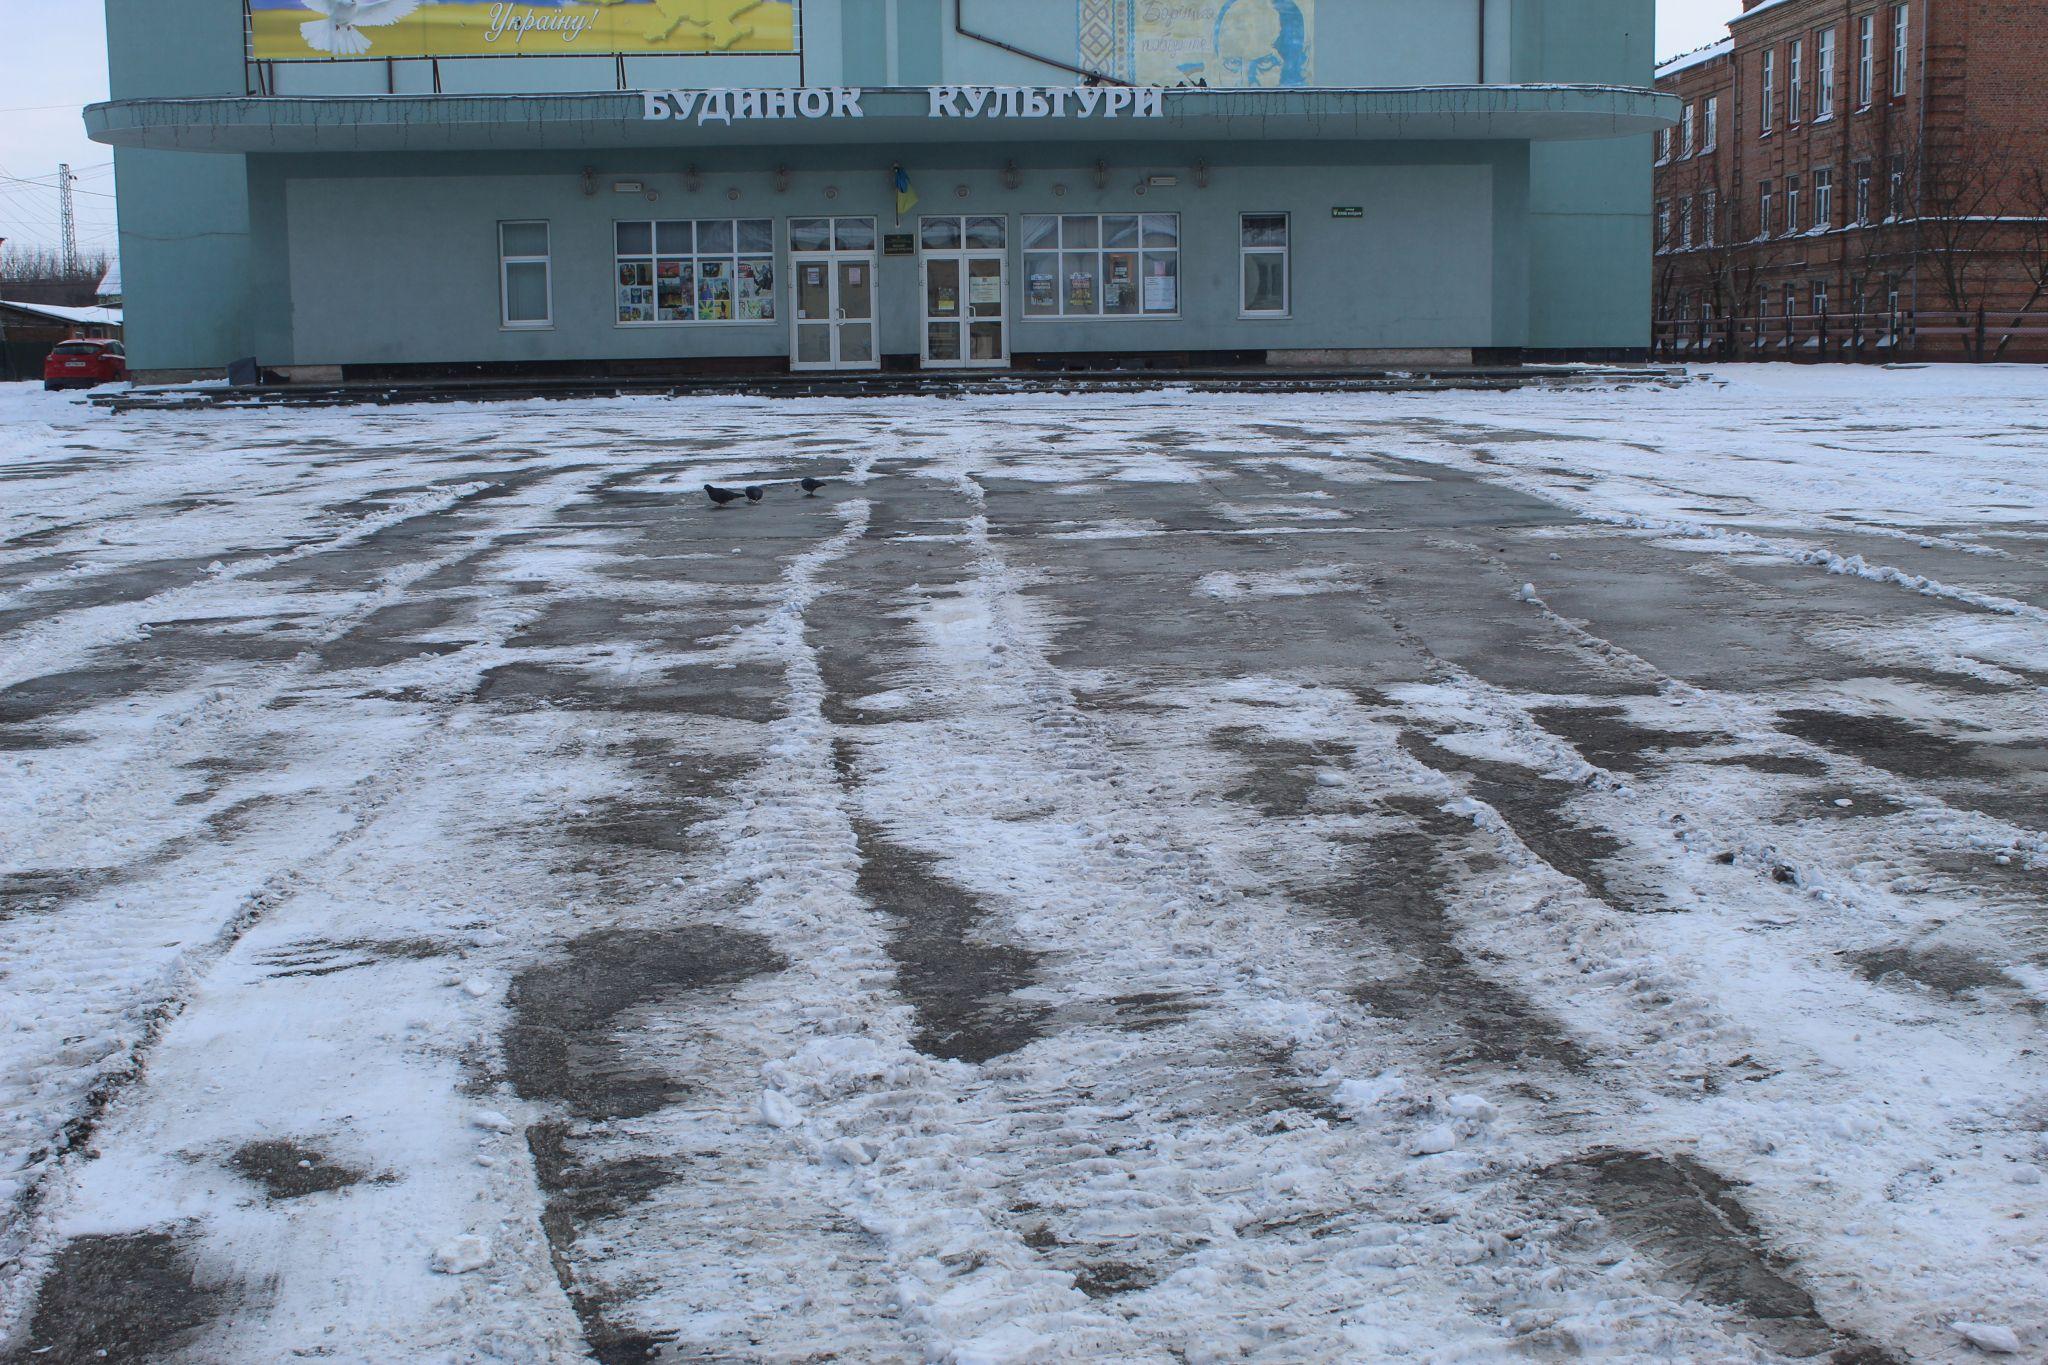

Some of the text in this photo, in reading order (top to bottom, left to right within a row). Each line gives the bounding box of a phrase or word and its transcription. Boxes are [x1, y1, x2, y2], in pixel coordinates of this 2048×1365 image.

[484, 2, 600, 44] Україну!
[642, 87, 1164, 126] БУДИНОК КУЛЬТУРИ
